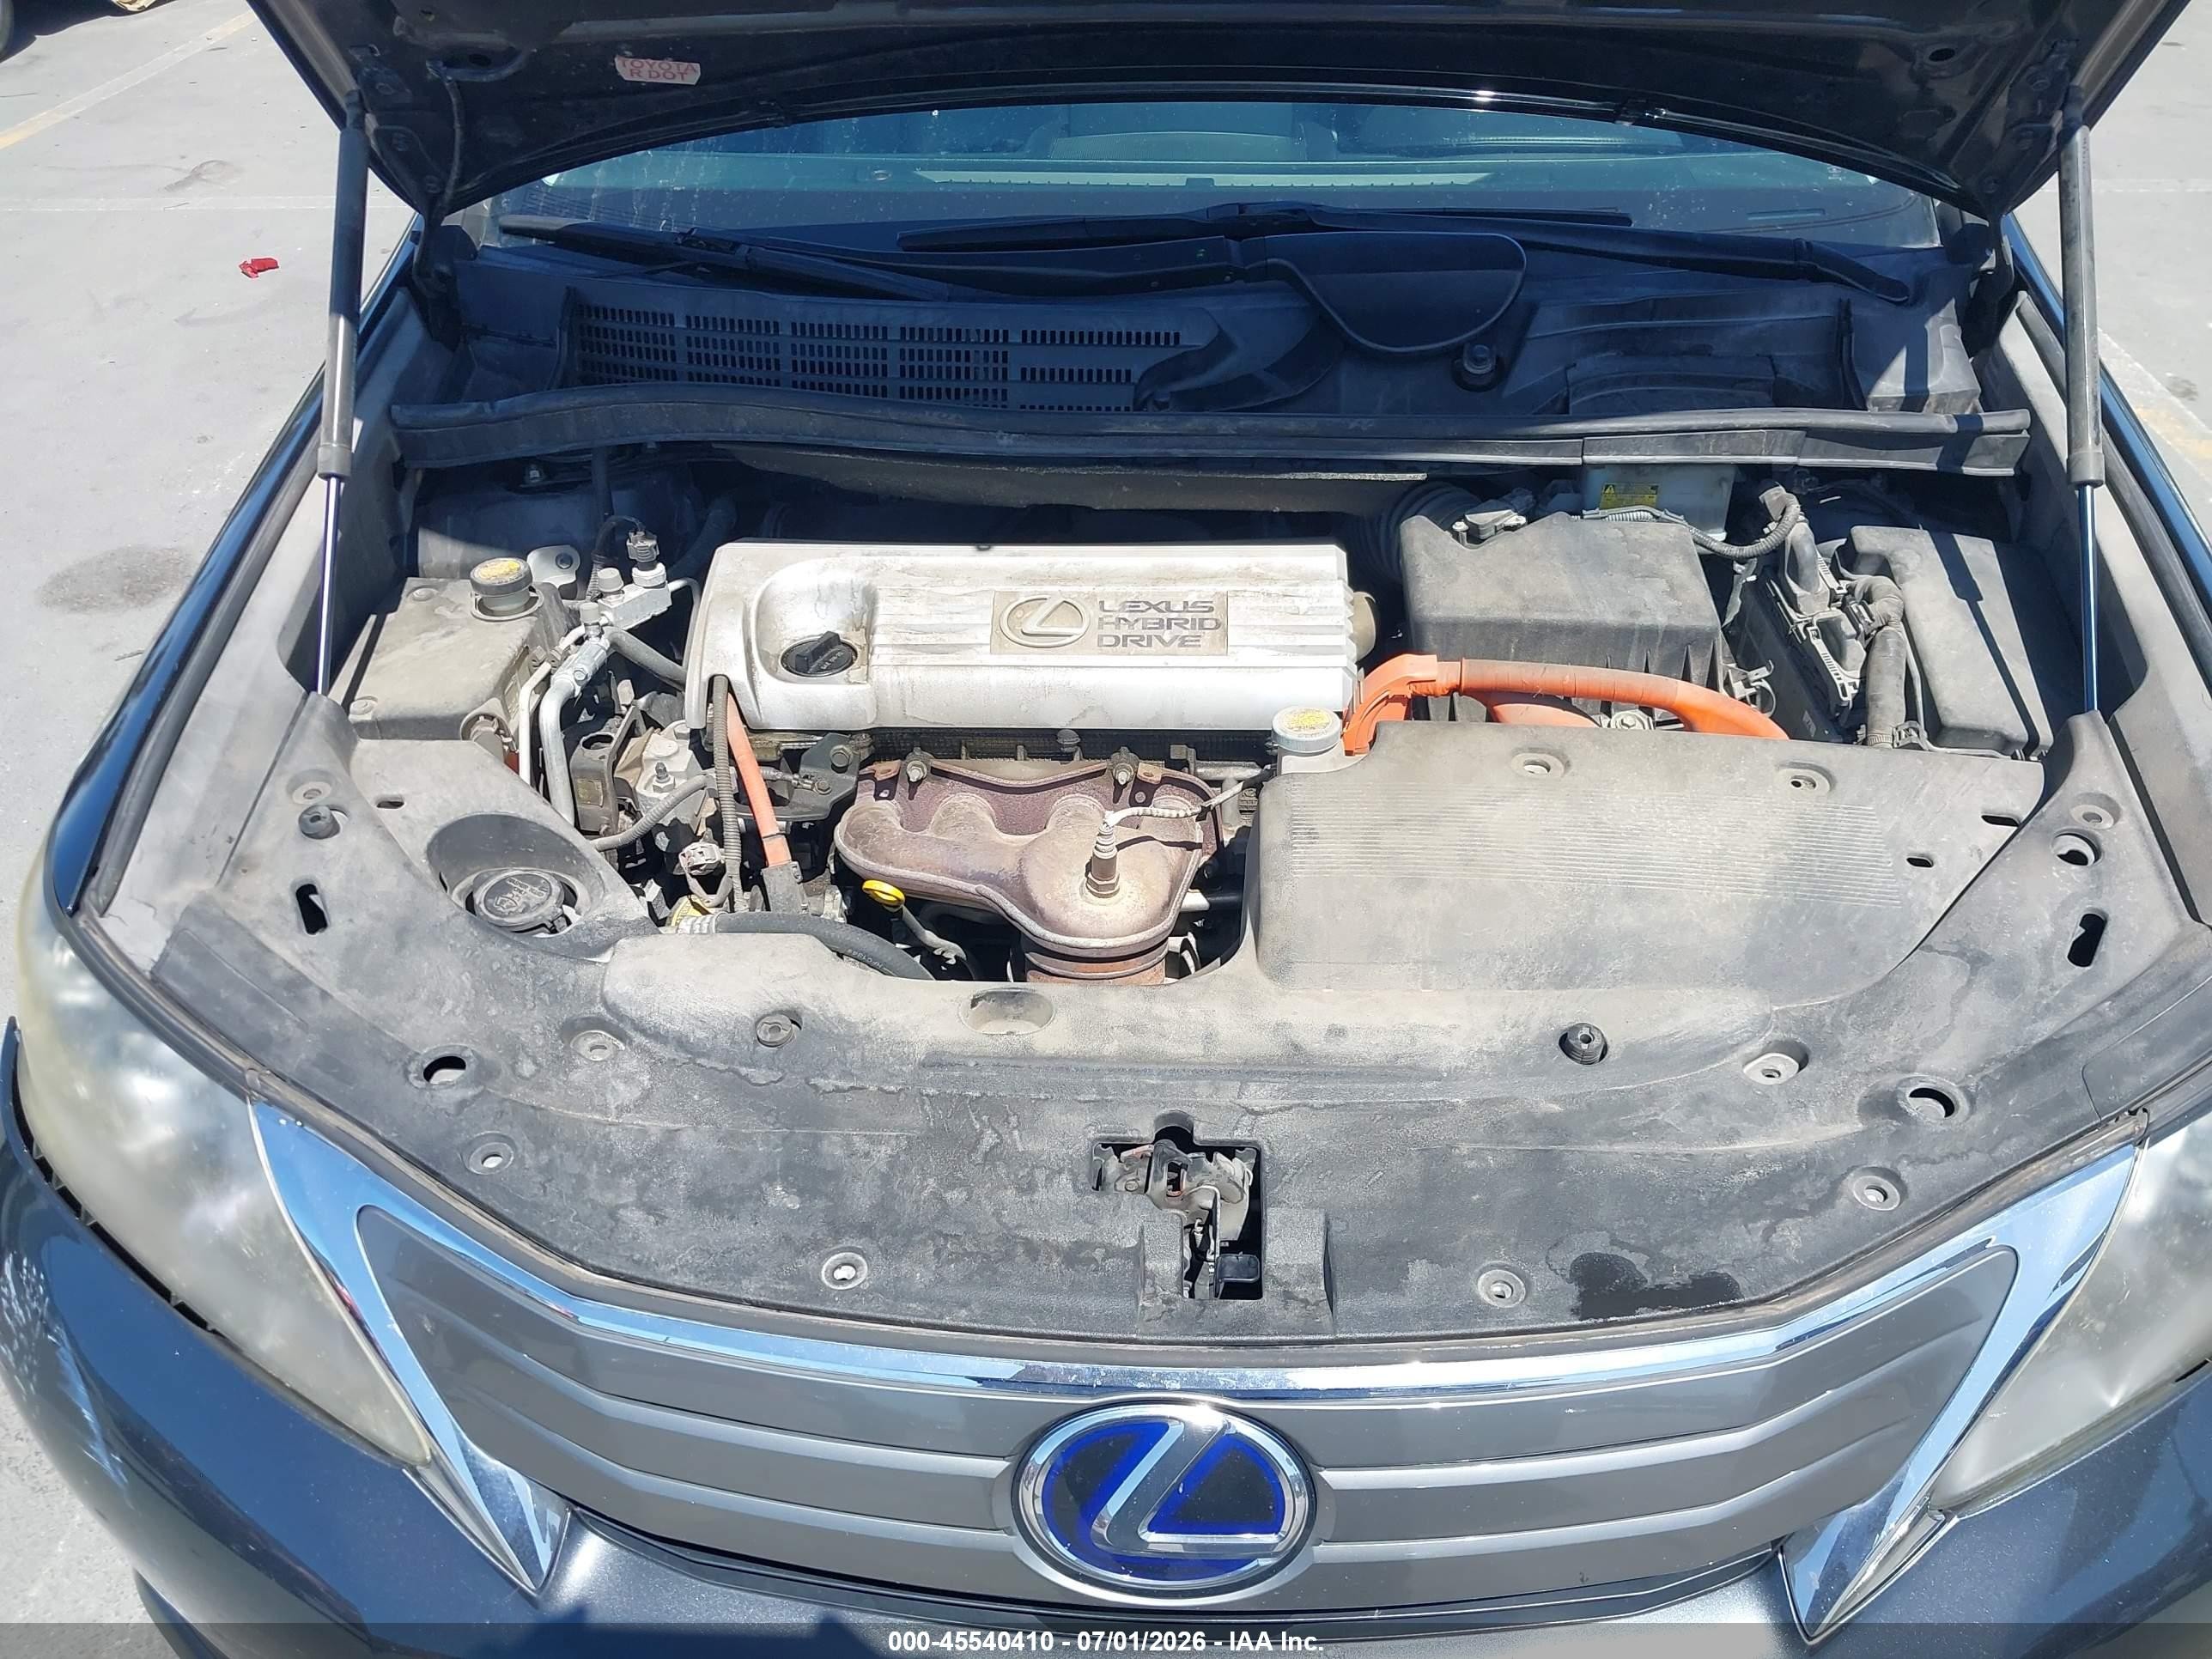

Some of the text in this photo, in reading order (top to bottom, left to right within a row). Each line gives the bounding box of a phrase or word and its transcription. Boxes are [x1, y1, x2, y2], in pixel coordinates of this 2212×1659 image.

[622, 60, 696, 73] TOYOTA
[630, 69, 688, 81] R DOT
[1098, 600, 1214, 613] LEXUS
[1097, 617, 1222, 630] HYBRID
[1097, 634, 1201, 647] DRIVE
